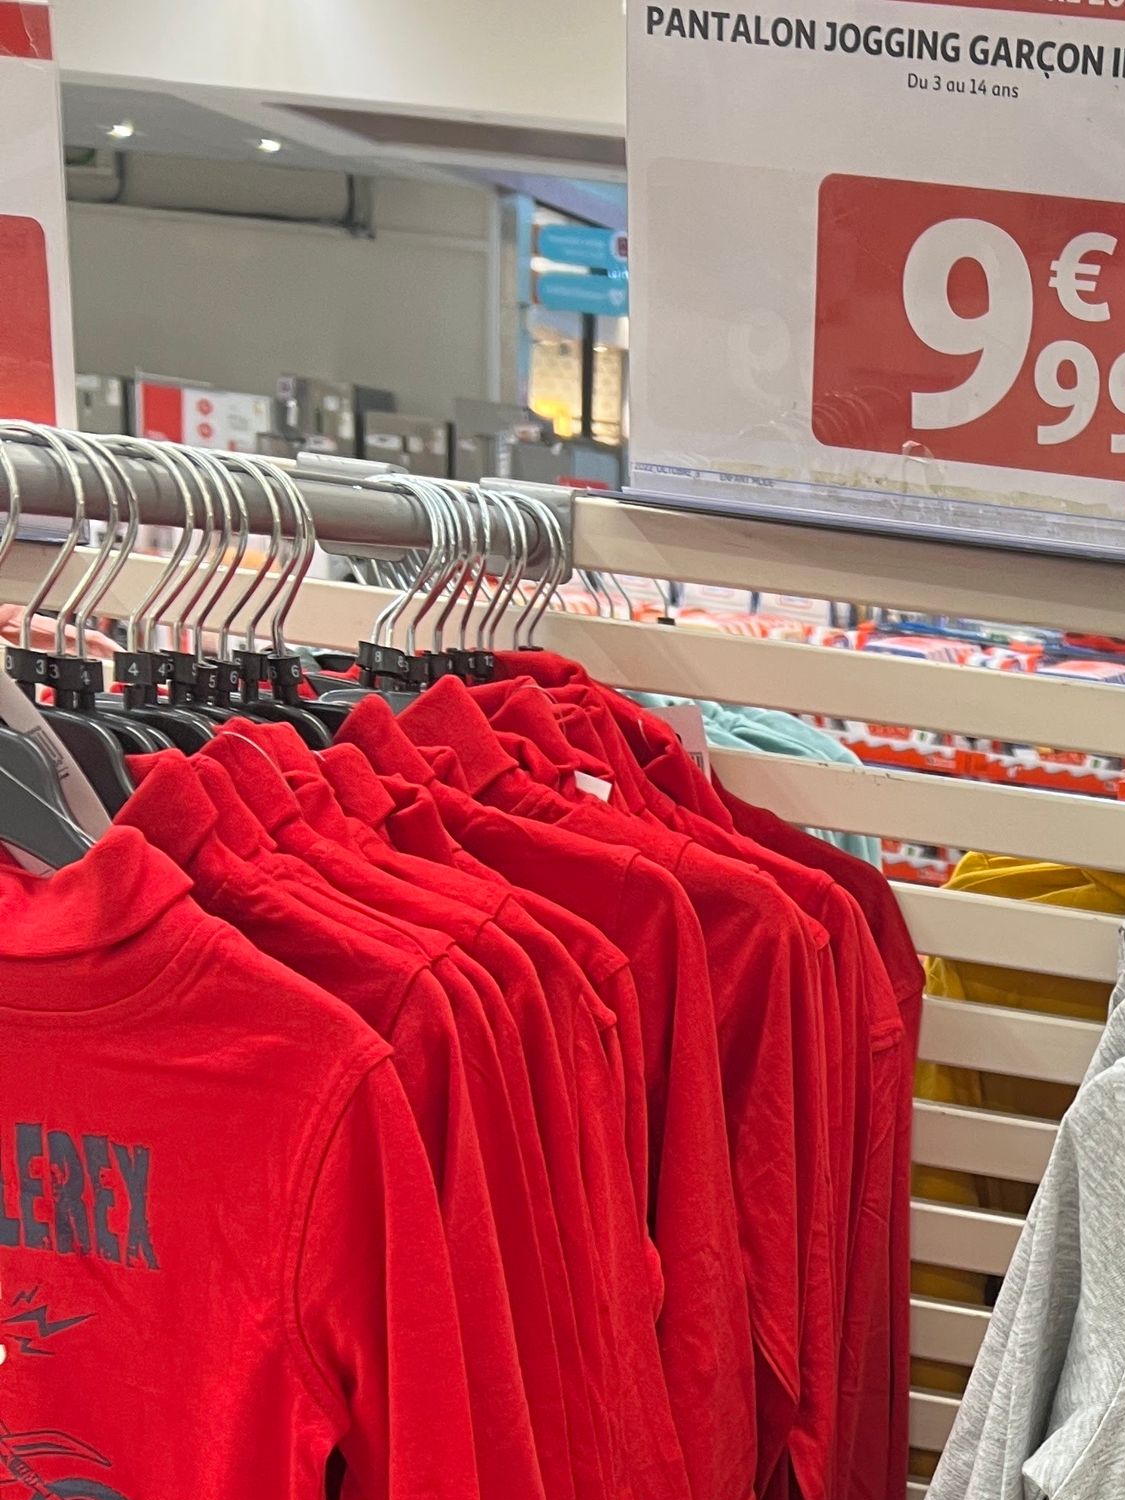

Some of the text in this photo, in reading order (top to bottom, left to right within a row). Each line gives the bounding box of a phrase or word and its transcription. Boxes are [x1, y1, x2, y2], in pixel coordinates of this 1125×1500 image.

[646, 5, 816, 50] PANTALON
[823, 21, 961, 63] JOGGING
[969, 35, 1104, 79] GARÇON
[907, 72, 1019, 98] Du 3 au 14 ans
[36, 658, 46, 675] 3
[128, 661, 140, 677] 4
[209, 674, 216, 689] 5
[230, 670, 238, 685] 6
